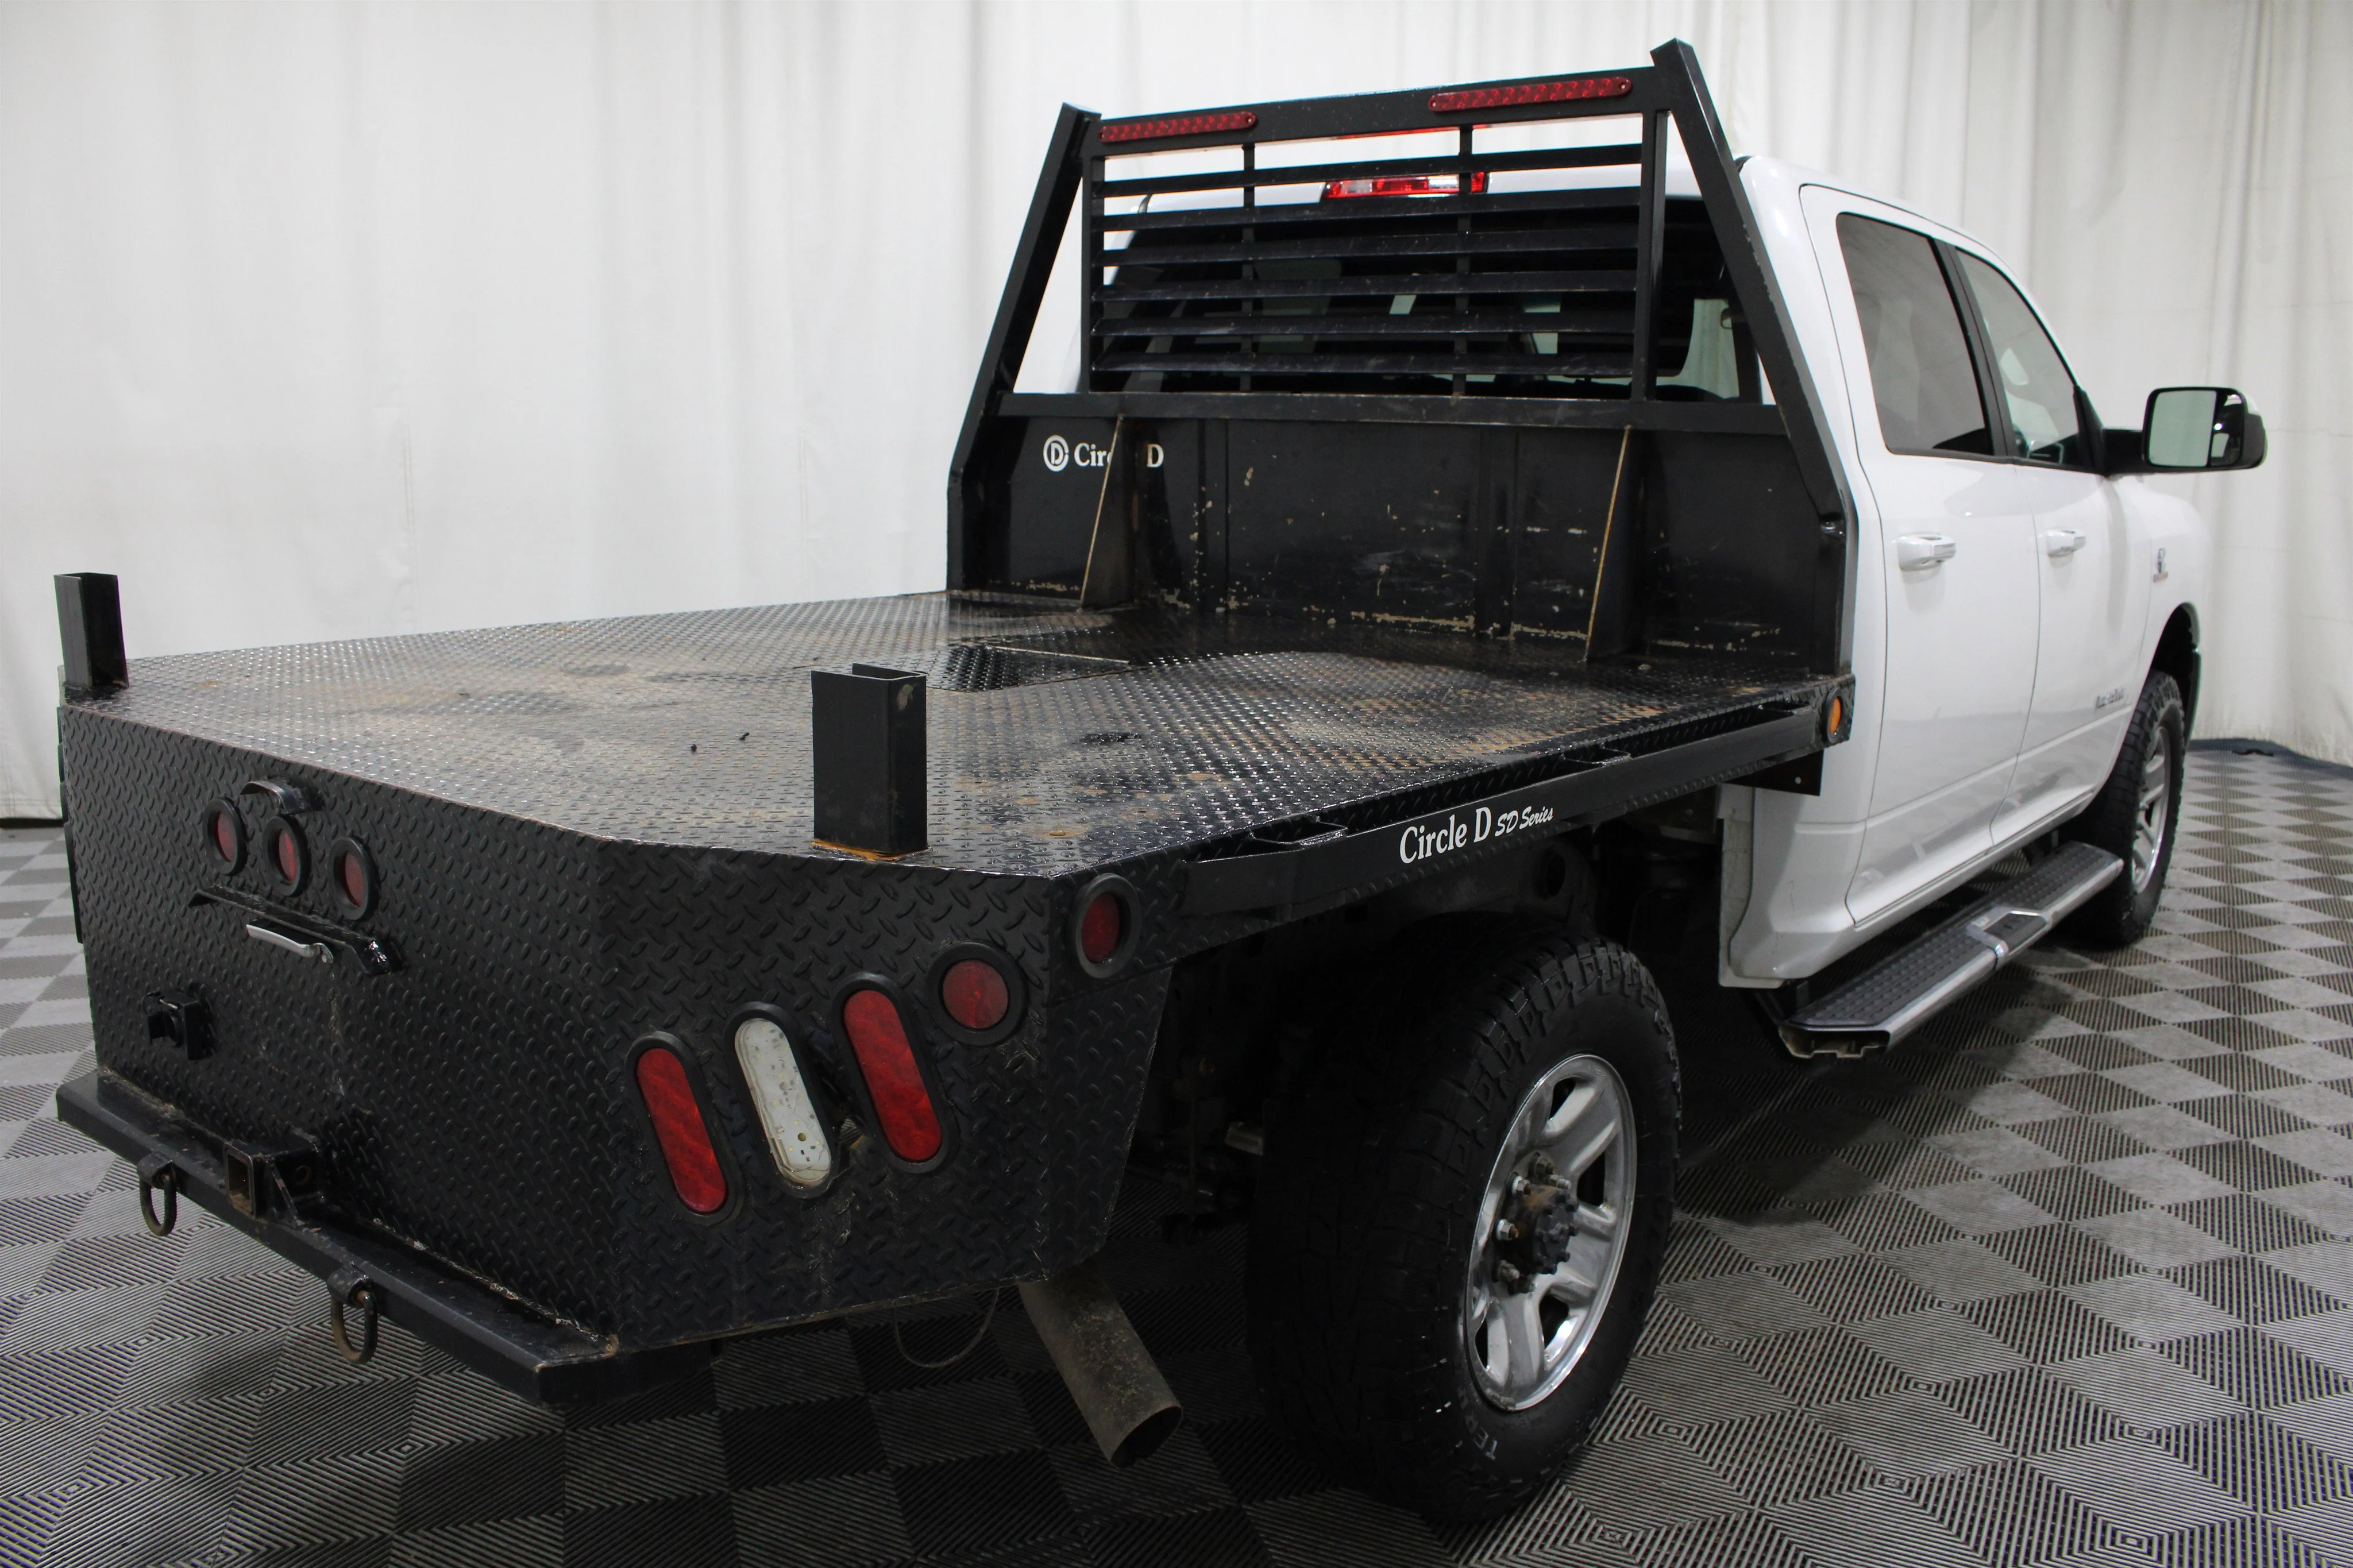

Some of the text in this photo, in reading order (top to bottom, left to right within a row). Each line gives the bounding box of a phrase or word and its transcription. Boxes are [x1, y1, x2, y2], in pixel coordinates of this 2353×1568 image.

[1400, 806, 1553, 864] Circle D SD Series
